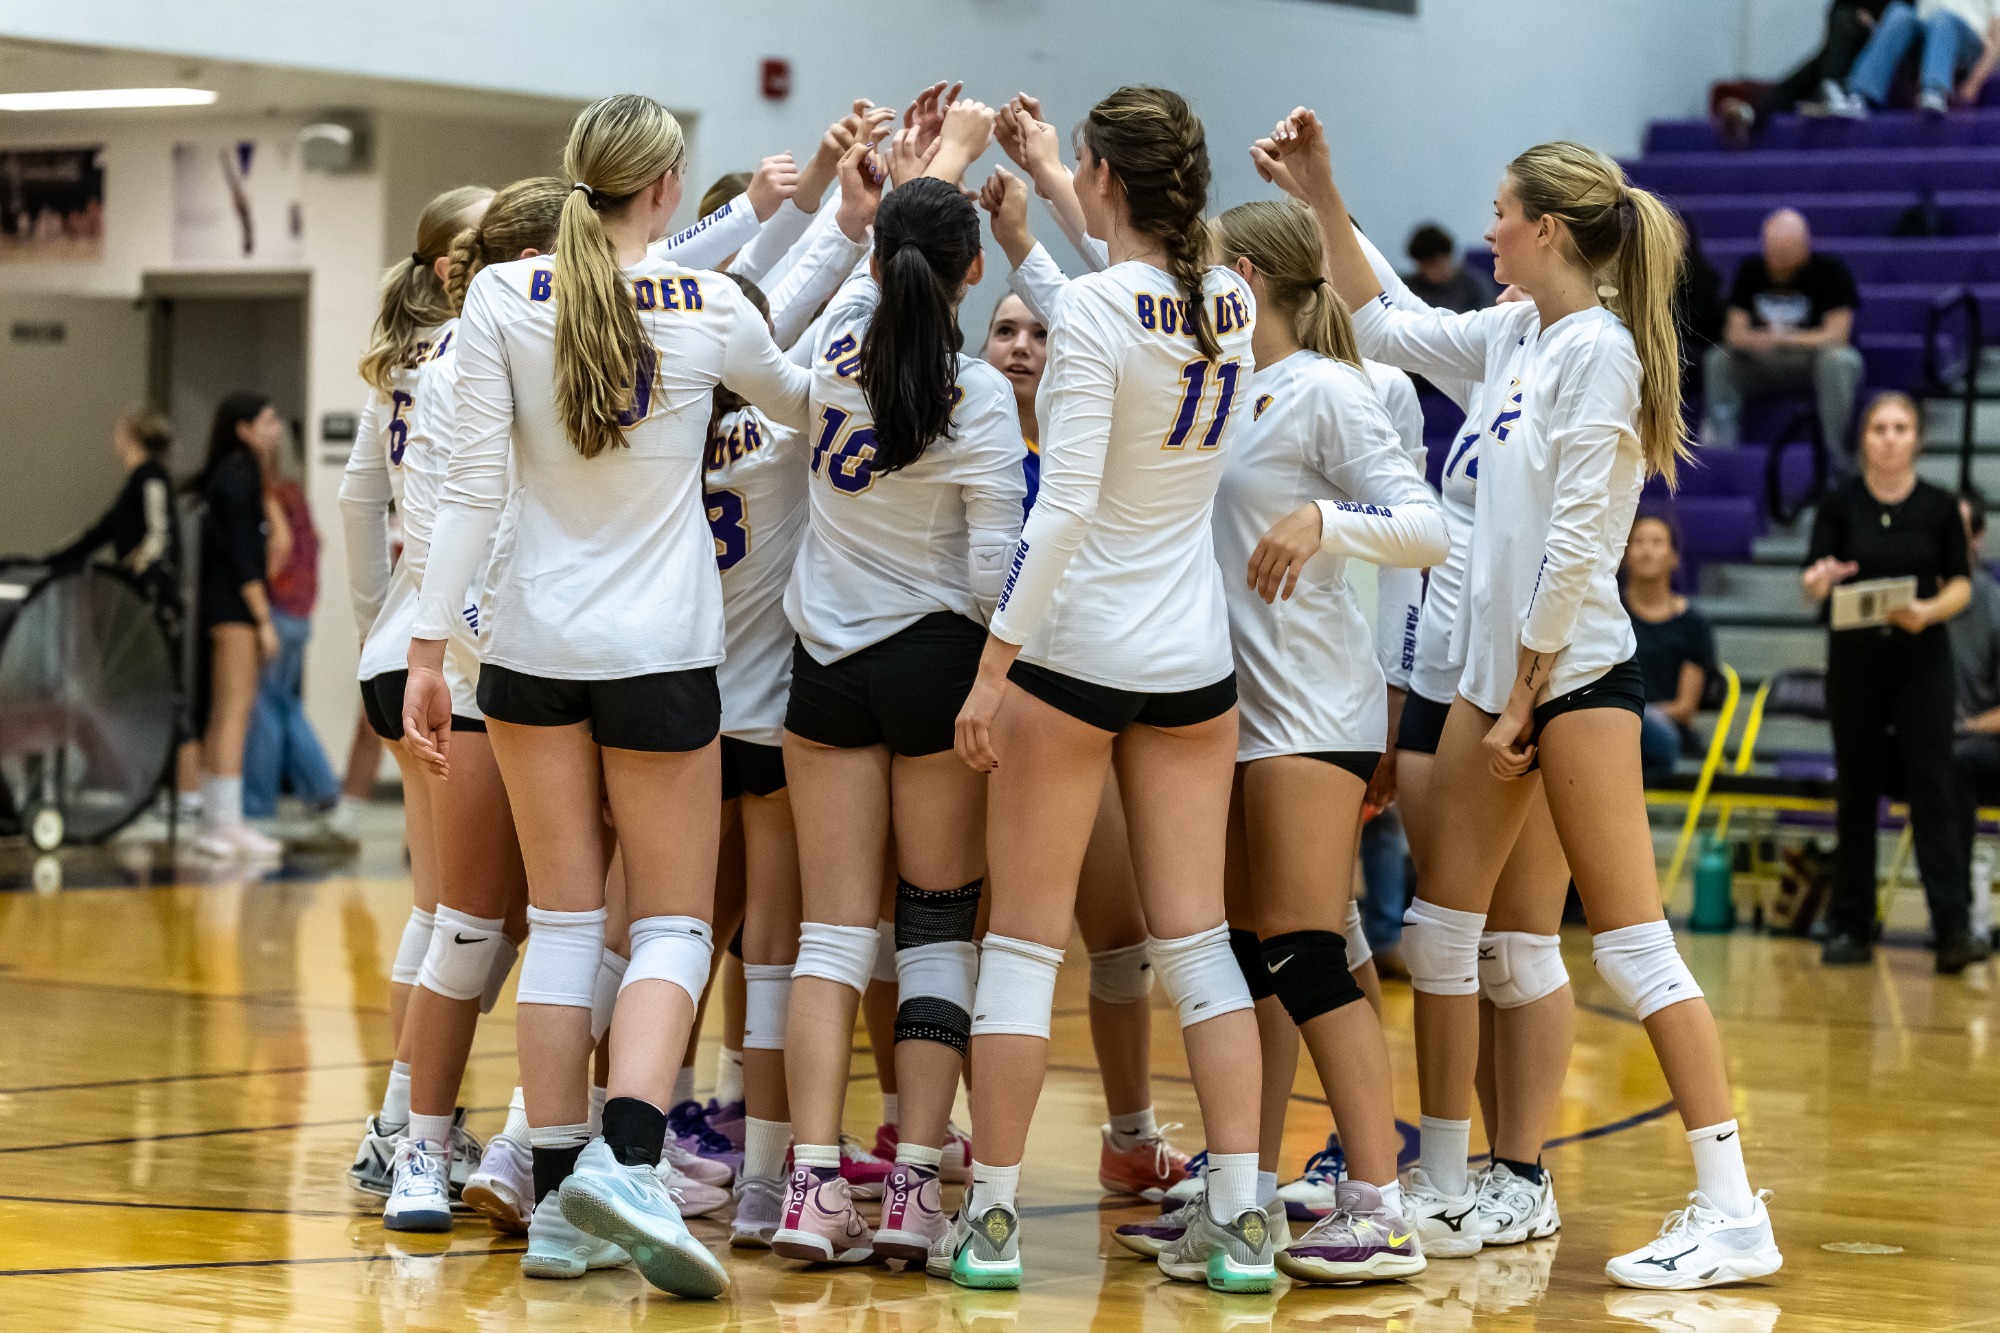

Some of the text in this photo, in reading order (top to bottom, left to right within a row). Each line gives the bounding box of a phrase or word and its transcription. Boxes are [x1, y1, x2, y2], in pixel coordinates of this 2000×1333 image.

[529, 269, 704, 313] BDER
[388, 389, 415, 470] 6
[1160, 356, 1242, 451] 11
[810, 402, 877, 498] 10
[998, 539, 1030, 613] PANTHERS
